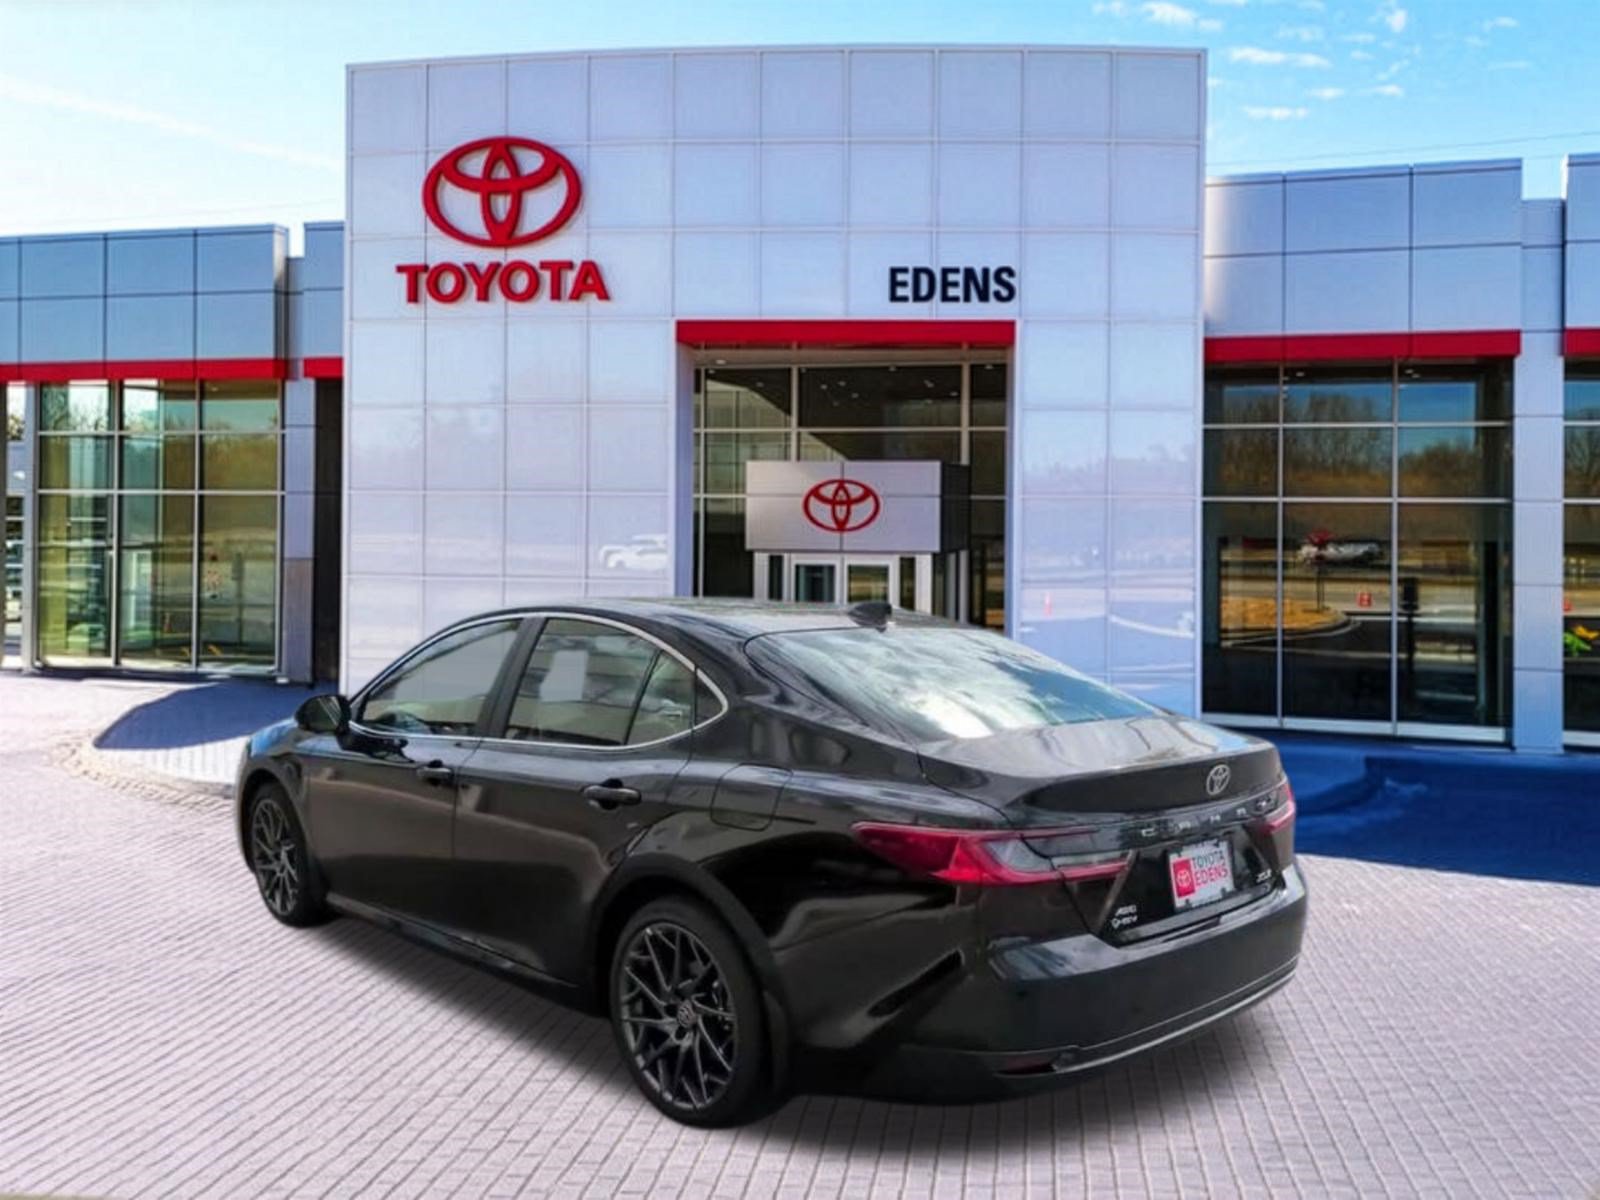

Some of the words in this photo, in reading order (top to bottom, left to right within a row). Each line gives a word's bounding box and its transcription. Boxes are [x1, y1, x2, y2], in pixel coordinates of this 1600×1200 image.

[396, 260, 611, 304] TOYOTA
[889, 266, 1017, 303] EDENS
[1191, 850, 1226, 869] TOYOTA
[1194, 866, 1229, 886] EDENS
